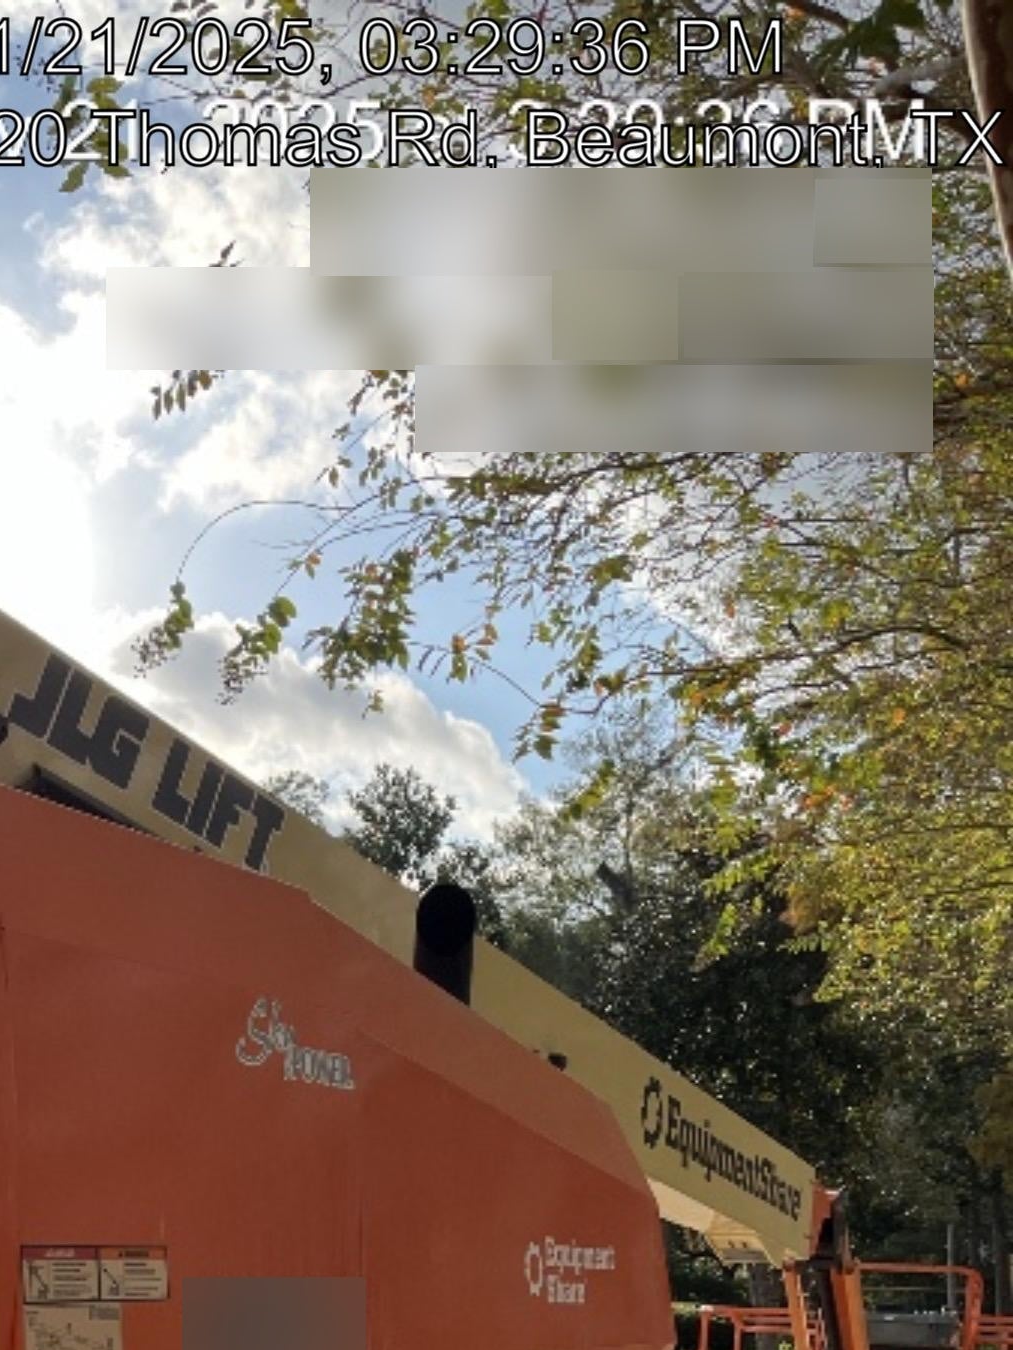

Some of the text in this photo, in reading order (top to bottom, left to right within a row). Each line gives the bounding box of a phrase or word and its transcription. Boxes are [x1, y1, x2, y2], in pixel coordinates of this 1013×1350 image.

[9, 653, 286, 873] JLG LIFT
[665, 1095, 801, 1221] EquipmentShare
